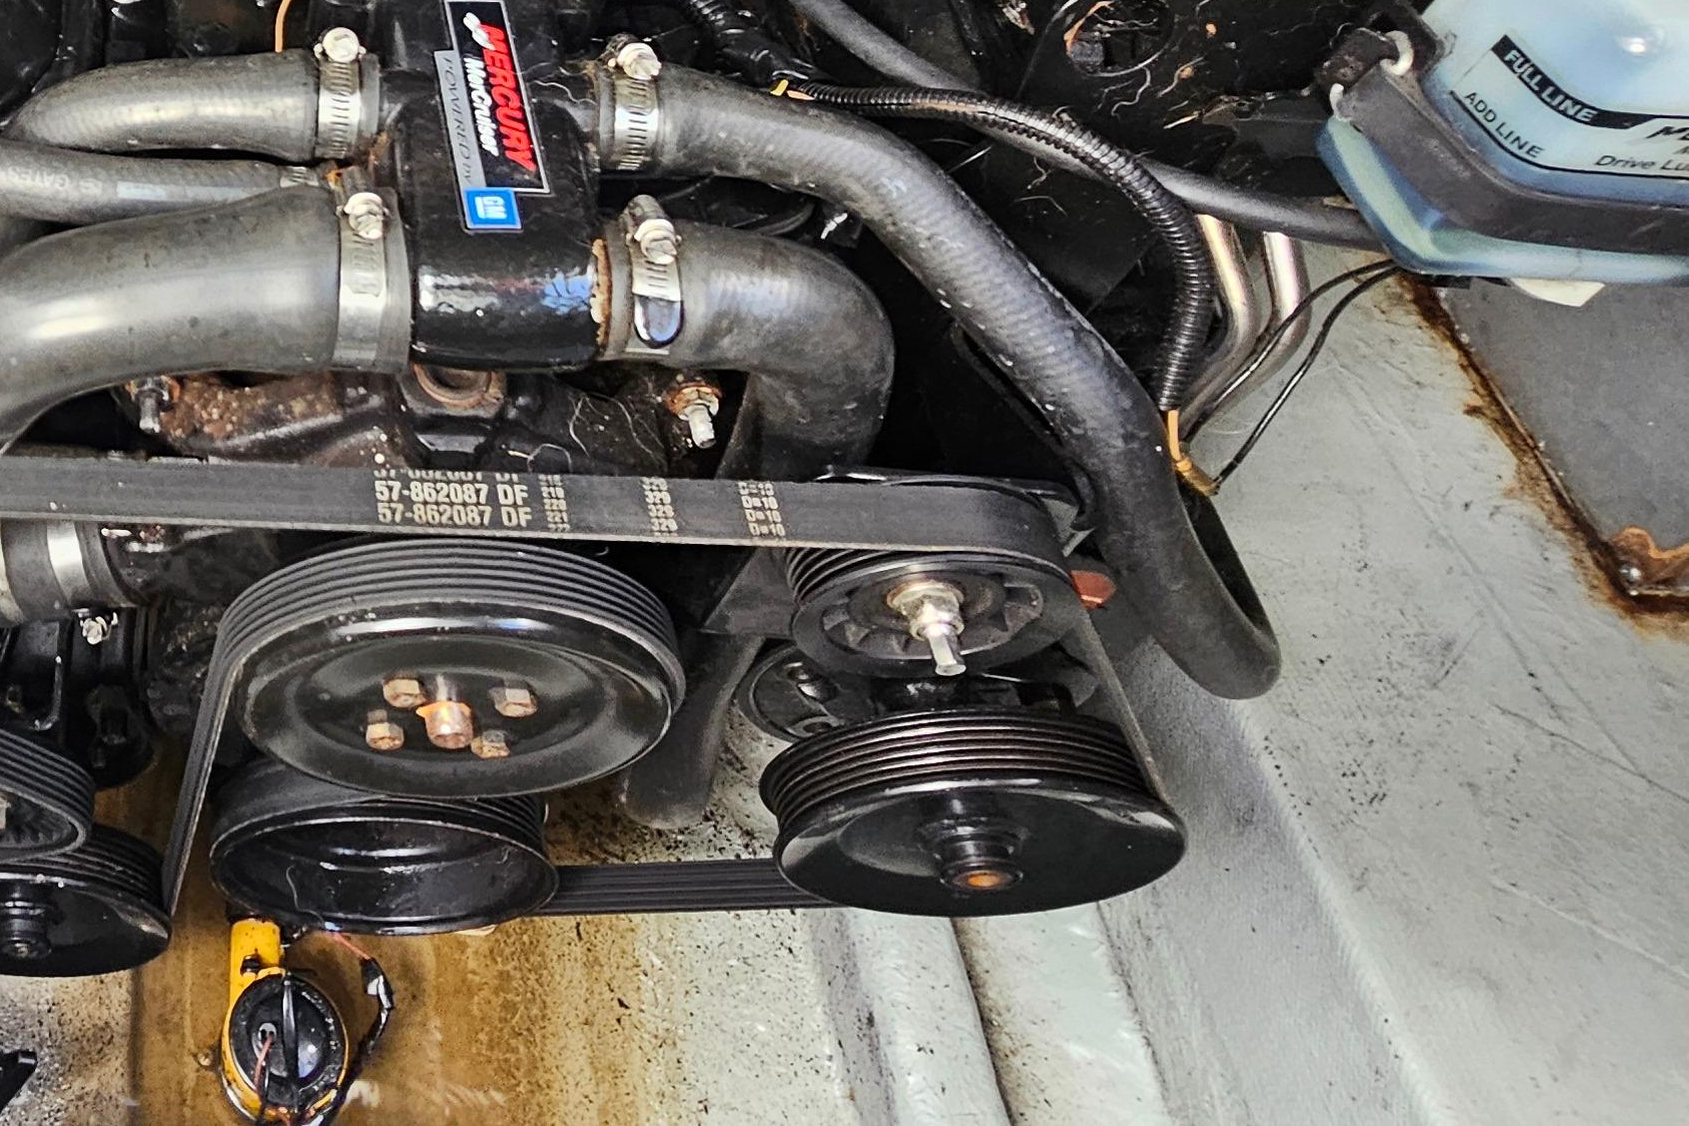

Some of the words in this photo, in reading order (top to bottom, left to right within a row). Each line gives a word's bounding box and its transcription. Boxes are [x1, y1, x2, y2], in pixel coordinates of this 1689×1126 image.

[463, 56, 500, 157] MerCruiser
[480, 21, 537, 172] MERCURY
[1503, 49, 1542, 91] FULL
[1542, 83, 1599, 123] LINE
[1463, 91, 1498, 124] ADD
[1498, 121, 1547, 159] LINE
[1595, 155, 1656, 170] Drive
[475, 195, 508, 219] GM
[374, 480, 489, 505] 57-862087
[497, 483, 530, 506] DF
[377, 501, 493, 526] 57-862087
[501, 506, 533, 528] DF
